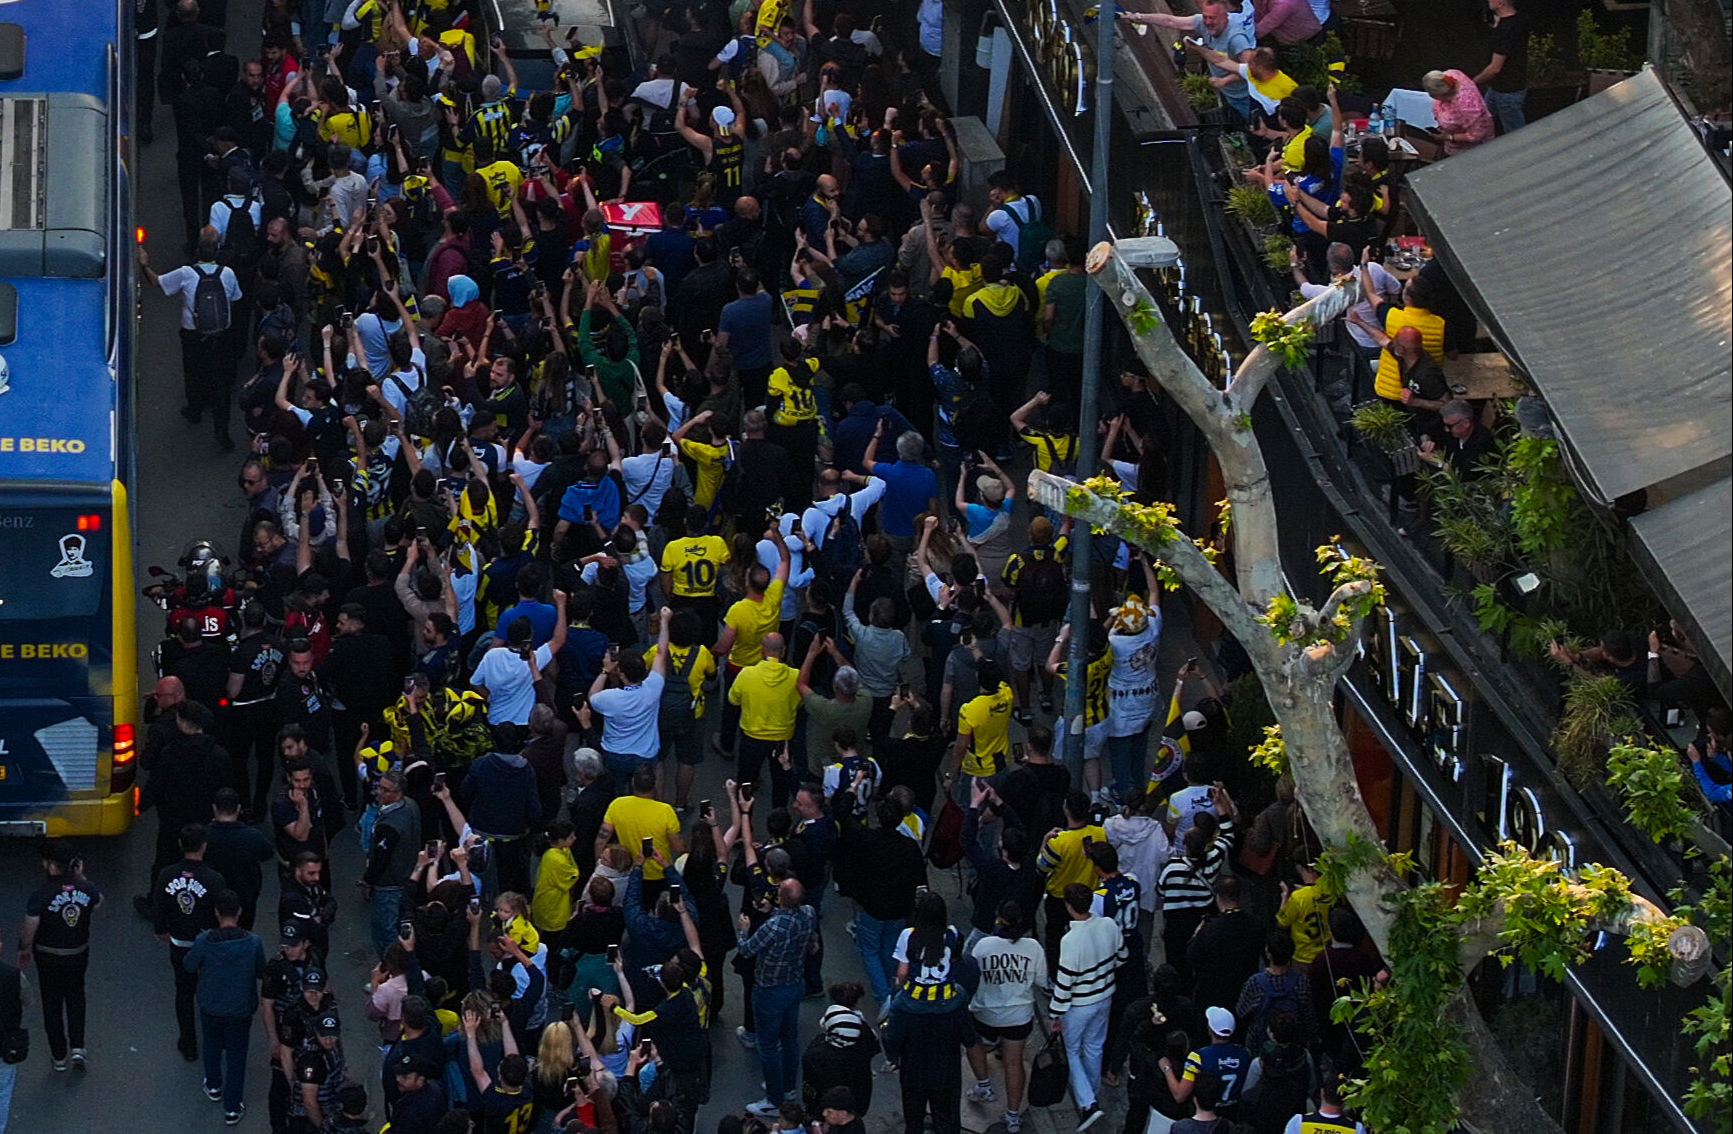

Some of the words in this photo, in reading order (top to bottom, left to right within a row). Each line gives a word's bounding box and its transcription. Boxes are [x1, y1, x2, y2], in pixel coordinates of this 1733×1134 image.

[724, 167, 741, 187] 11
[19, 438, 86, 453] BEKO
[681, 558, 716, 587] 10
[20, 643, 88, 659] BEKO
[165, 877, 187, 896] SPOR
[48, 891, 71, 913] SPOR
[982, 957, 989, 972] I
[991, 953, 1031, 971] DON'T
[982, 970, 1030, 985] WANNA
[1220, 1074, 1237, 1101] 7
